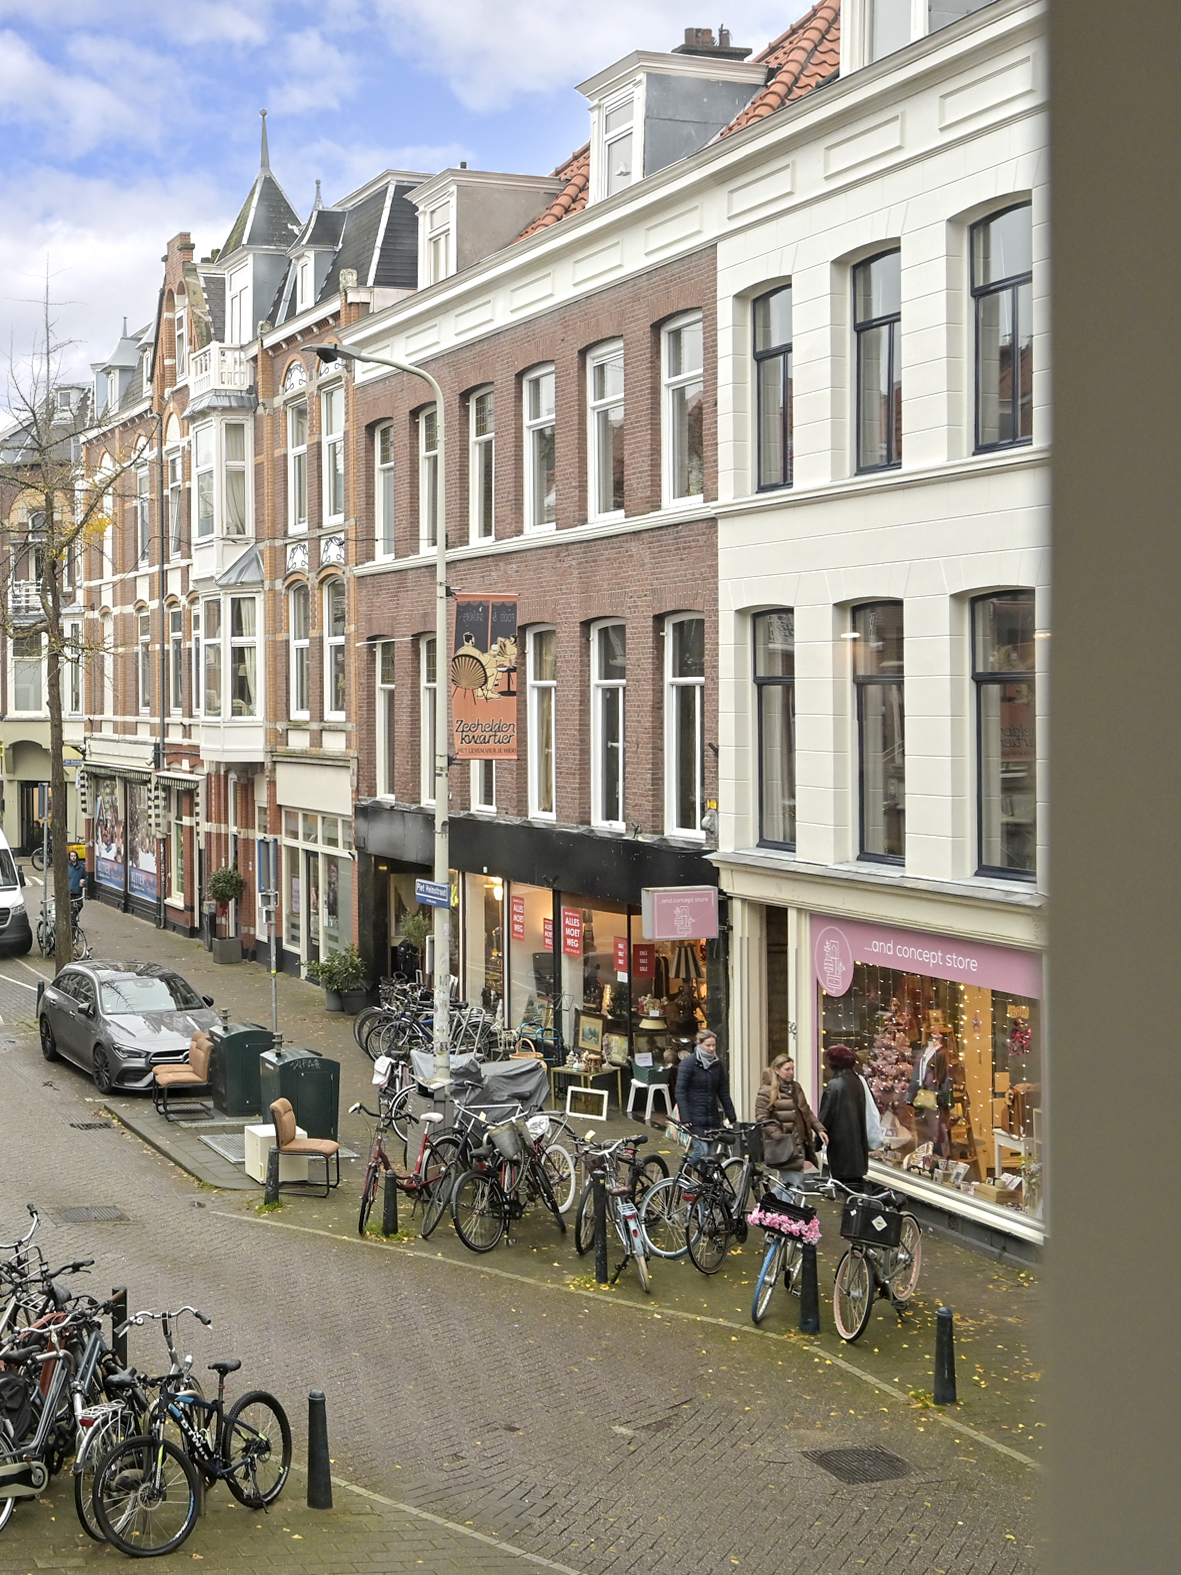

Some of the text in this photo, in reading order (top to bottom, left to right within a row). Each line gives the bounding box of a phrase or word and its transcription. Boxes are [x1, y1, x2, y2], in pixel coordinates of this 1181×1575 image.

[455, 718, 516, 734] Zeehelden
[460, 733, 515, 745] kwartier
[417, 882, 425, 892] Piet
[565, 917, 580, 927] ALLES
[565, 927, 580, 937] MOET
[566, 938, 579, 948] WEG
[864, 940, 978, 972] ...and concept store
